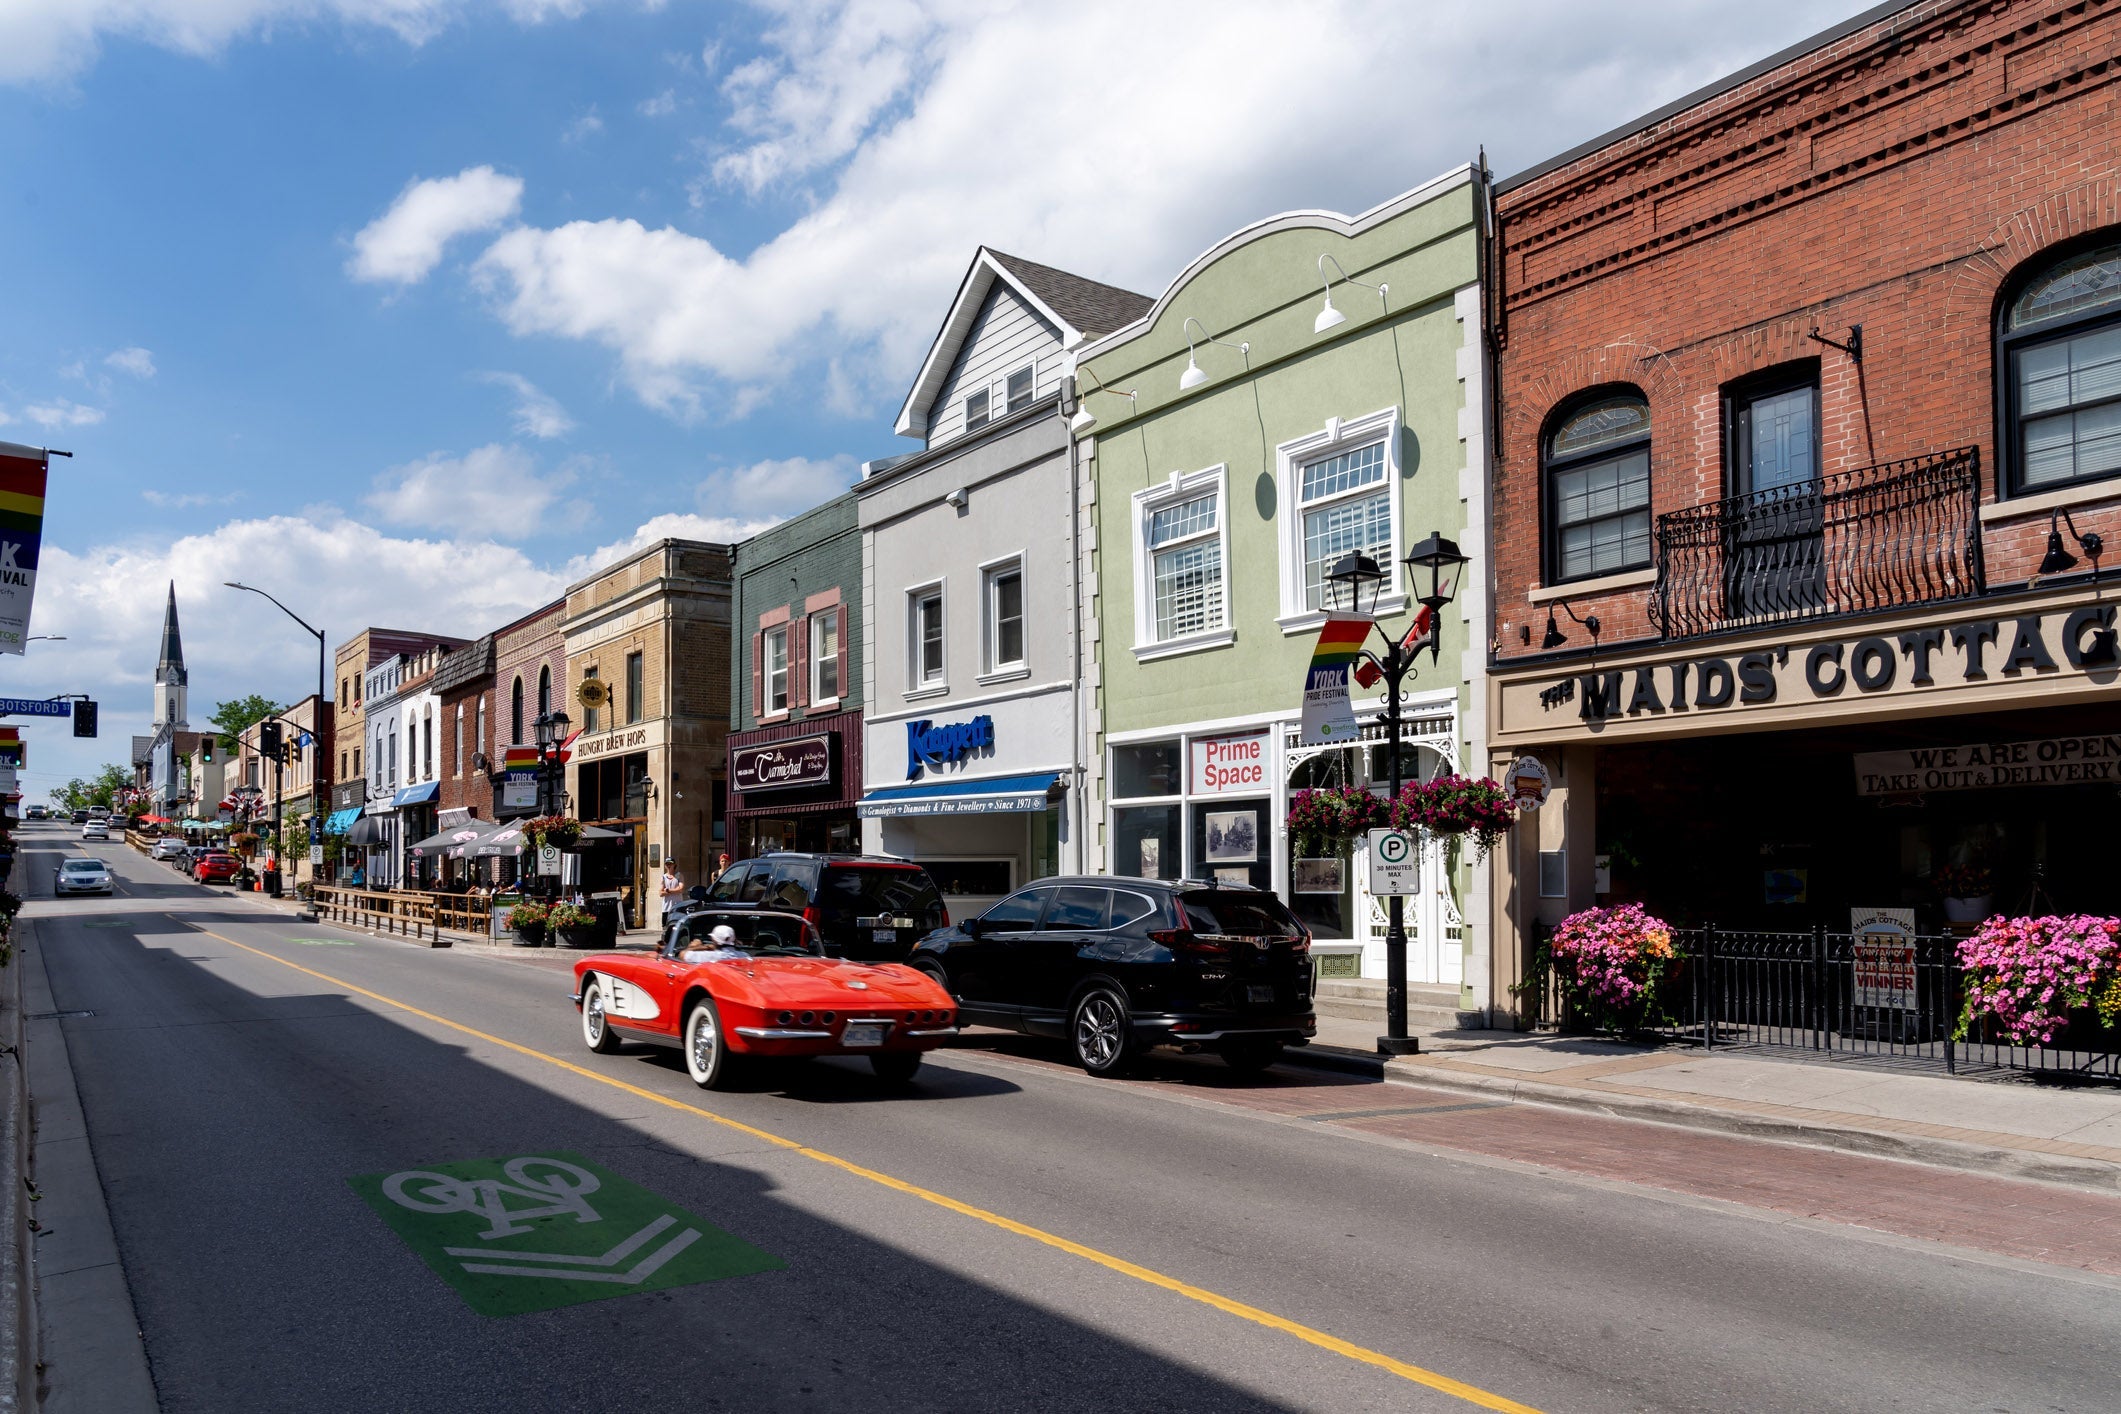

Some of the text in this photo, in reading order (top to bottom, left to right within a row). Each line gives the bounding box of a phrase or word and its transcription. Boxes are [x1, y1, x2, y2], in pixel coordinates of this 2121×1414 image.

[1314, 670, 1343, 690] YORK
[1539, 679, 1574, 706] THE
[1579, 645, 1789, 720] MAIDS'
[1306, 688, 1349, 701] PRIDE FESTIVAL
[578, 729, 646, 757] HUNGRY BREW HOPS
[905, 714, 995, 781] Knappett
[1206, 738, 1261, 763] Prime
[1910, 737, 2121, 769] WE ARE OPEN
[510, 773, 534, 782] YORK
[1204, 763, 1263, 791] Space
[1863, 774, 1919, 792] TAKE
[1925, 770, 1973, 789] OUT
[1975, 773, 1987, 786] &
[1992, 762, 2113, 786] DELIVERY
[867, 798, 1031, 816] Gemologist Diamonds & Fine Jewellery Since 1971
[1388, 840, 1400, 856] P
[1878, 917, 1914, 933] COTTAGE
[1857, 974, 1914, 991] WINNER
